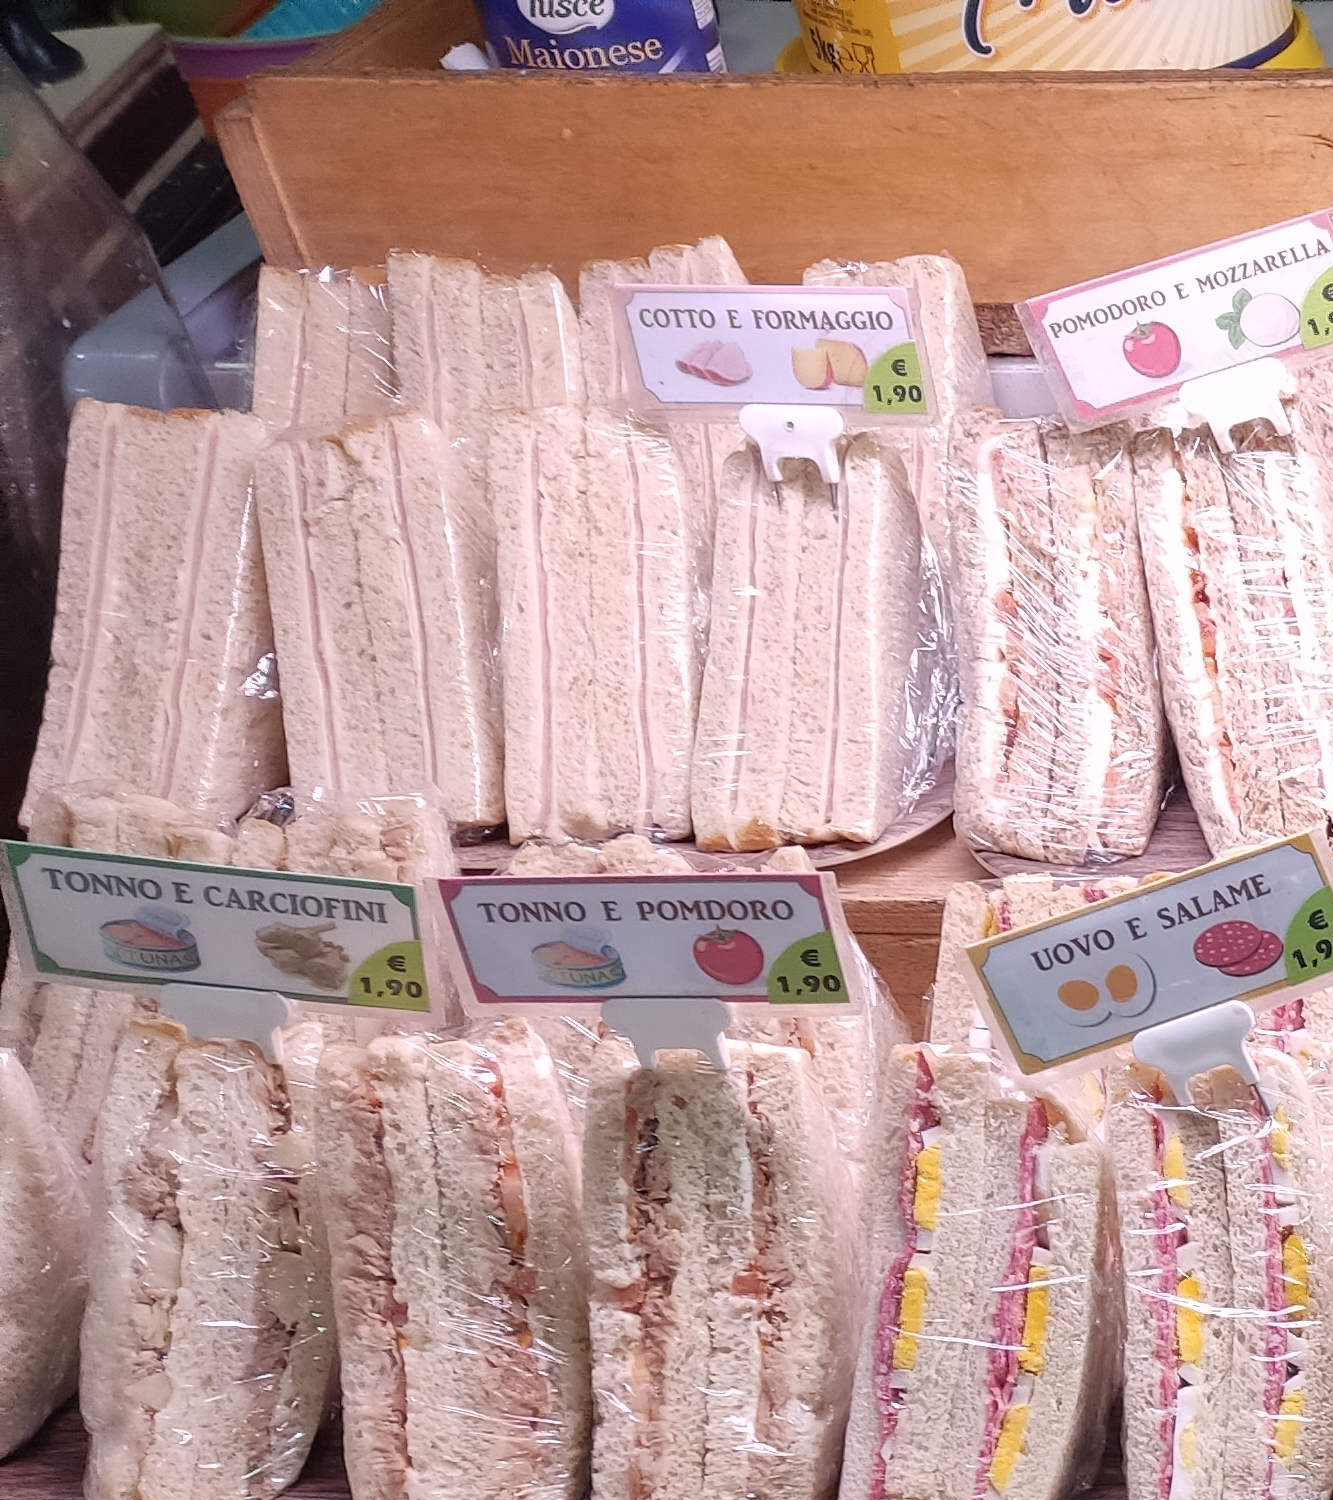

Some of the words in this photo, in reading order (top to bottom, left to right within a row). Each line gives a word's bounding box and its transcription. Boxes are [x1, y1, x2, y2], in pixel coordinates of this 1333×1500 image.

[503, 37, 663, 70] Maionese
[1049, 287, 1166, 338] POMODORO
[1173, 282, 1190, 300] E
[1196, 238, 1331, 294] MOZZARELLA
[639, 308, 716, 329] COTTO
[728, 309, 742, 329] E
[752, 309, 893, 331] FORMAGGIO
[891, 359, 907, 377] €
[873, 385, 922, 406] 1,90
[41, 867, 163, 901] TONNO
[174, 882, 194, 904] E
[203, 886, 389, 924] CARCIOFINI
[477, 900, 587, 924] TONNO
[604, 900, 622, 921] E
[637, 899, 794, 921] POMDORO
[1030, 929, 1115, 971] UOVO
[1124, 917, 1147, 940] E
[1156, 874, 1271, 930] SALAME
[1308, 909, 1329, 930] €
[386, 955, 406, 973] €
[801, 949, 821, 966] €
[359, 977, 423, 999] 1,90
[776, 975, 842, 995] 1,90
